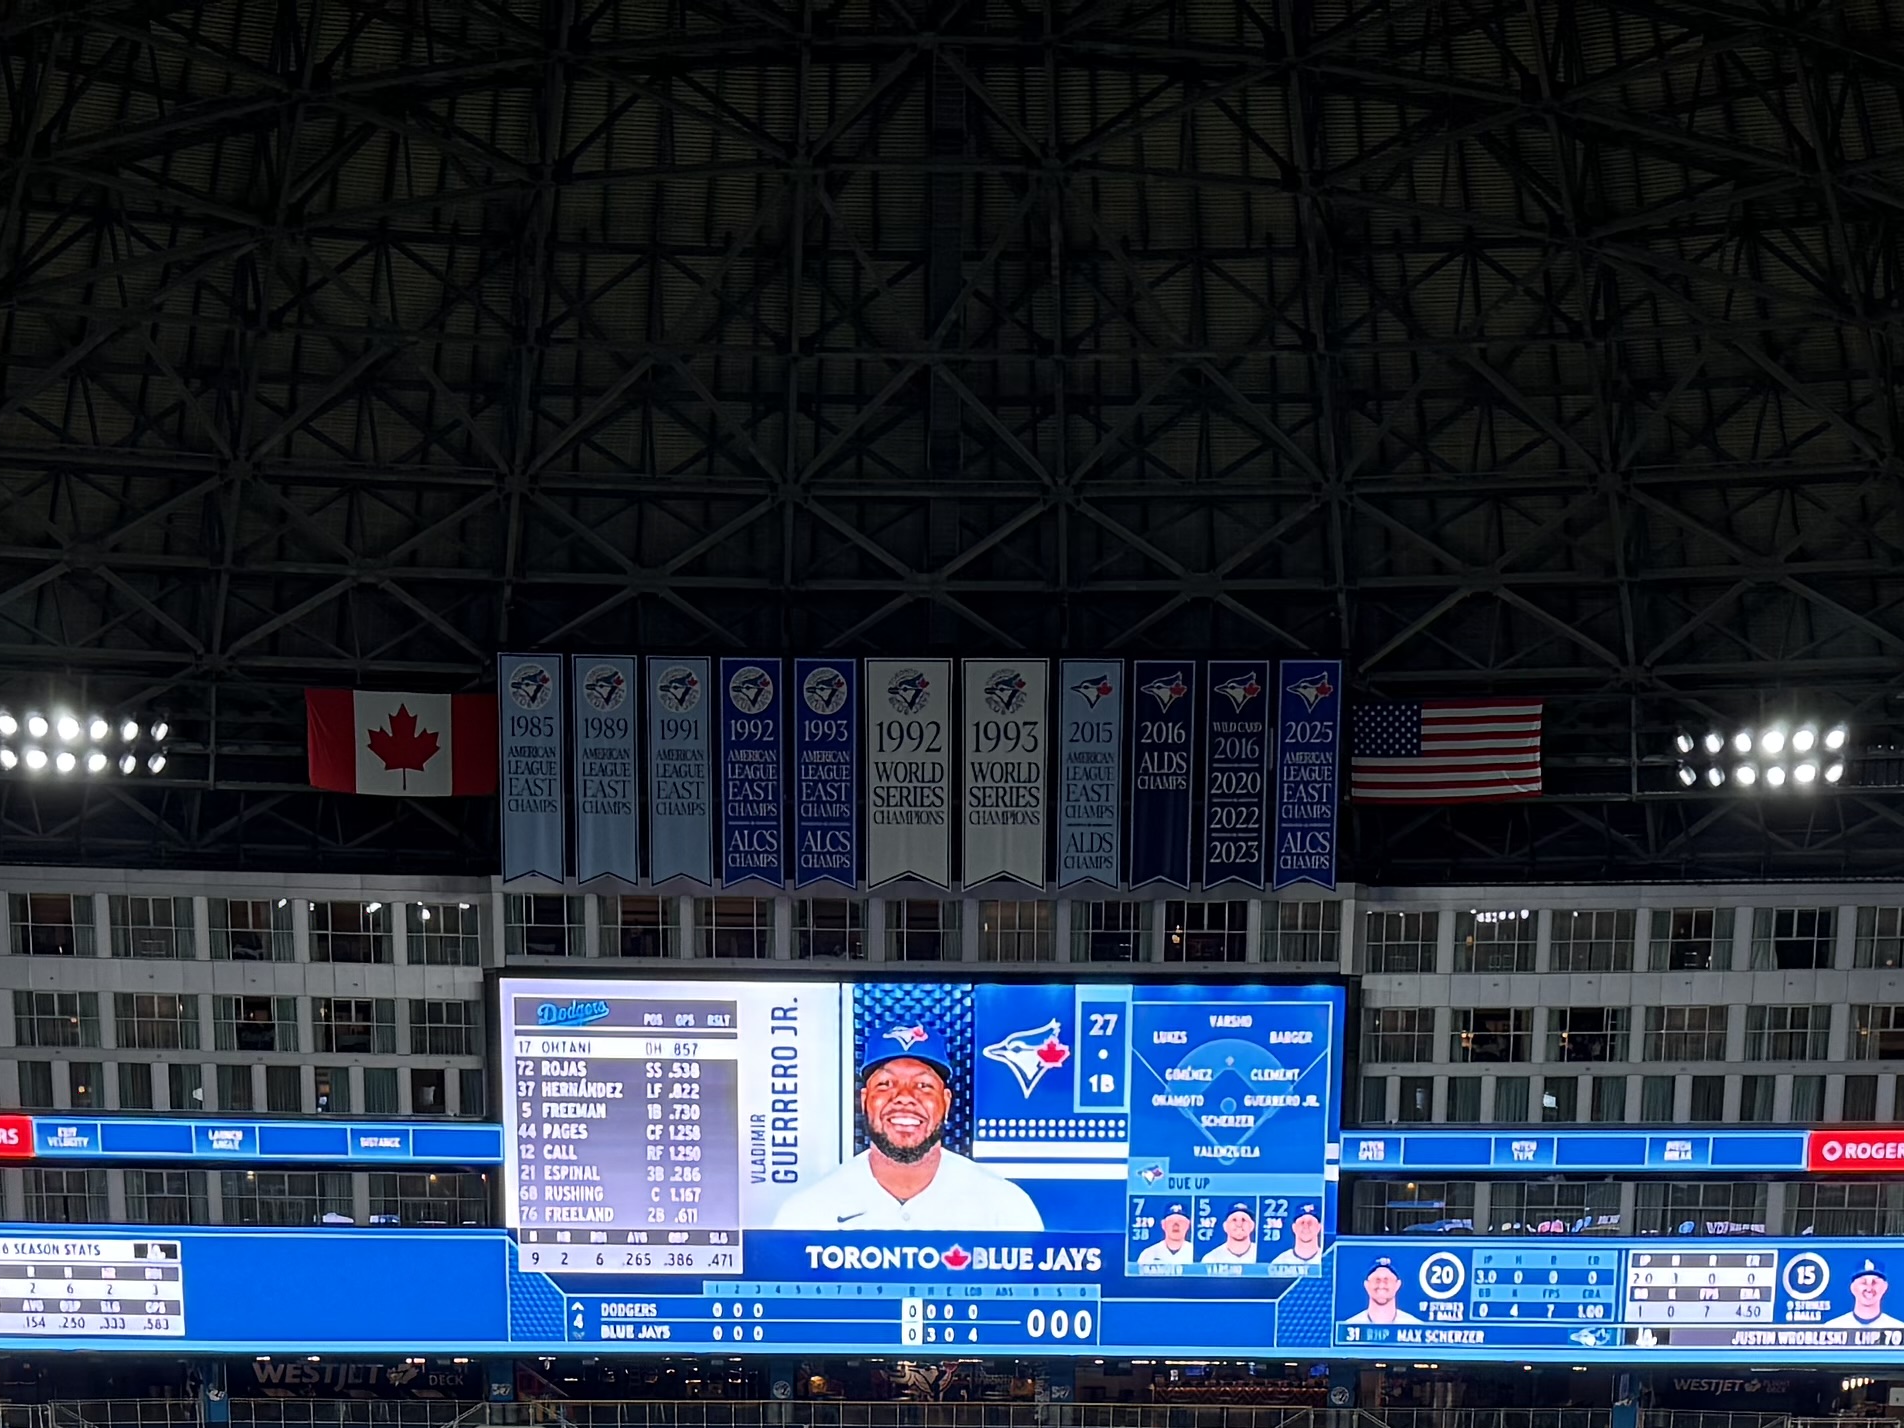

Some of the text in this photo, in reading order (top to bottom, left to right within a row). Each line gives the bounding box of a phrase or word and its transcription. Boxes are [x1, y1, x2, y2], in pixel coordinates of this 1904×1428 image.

[510, 716, 554, 738] 1985
[584, 717, 628, 738] 1989
[660, 719, 699, 740] 1991
[730, 719, 774, 741] 1992
[804, 720, 848, 741] 1993
[876, 721, 941, 753] 1992
[972, 721, 1038, 753] 1993
[1069, 722, 1113, 743] 2015
[1140, 722, 1185, 744] 2016
[1285, 722, 1333, 743] 2025
[874, 761, 944, 784] WORLD
[969, 762, 1040, 784] WORLD
[1140, 752, 1187, 773] ALDS
[1211, 772, 1260, 794] 2020
[874, 786, 944, 808] SERIES
[969, 787, 1040, 808] SERIES
[1211, 807, 1259, 828] 2022
[729, 830, 777, 851] ALCS
[802, 831, 850, 852] ALCS
[1210, 841, 1258, 862] 2023
[1089, 1014, 1118, 1036] 27
[542, 1061, 587, 1076] ROJAS
[771, 997, 798, 1184] GUERRERO JR.
[542, 1103, 606, 1119] FREEMAN
[542, 1124, 588, 1139] PAGES
[543, 1145, 577, 1160] CALL
[751, 1113, 766, 1184] VLADIMIR
[544, 1166, 600, 1181] ESPINAL
[1169, 1178, 1191, 1189] DUE
[545, 1186, 603, 1202] RUSHING
[545, 1207, 614, 1222] FREELAND
[15, 1244, 100, 1255] SEASON STATS
[805, 1245, 1101, 1271] TORONTO BLUE JAYS
[1430, 1266, 1453, 1284] 20
[601, 1304, 656, 1317] DODGERS
[601, 1326, 671, 1339] BLUE JAYS
[1426, 1330, 1484, 1343] SCHERZER
[254, 1362, 380, 1386] WESTJET
[1674, 1379, 1744, 1395] WESTJET
